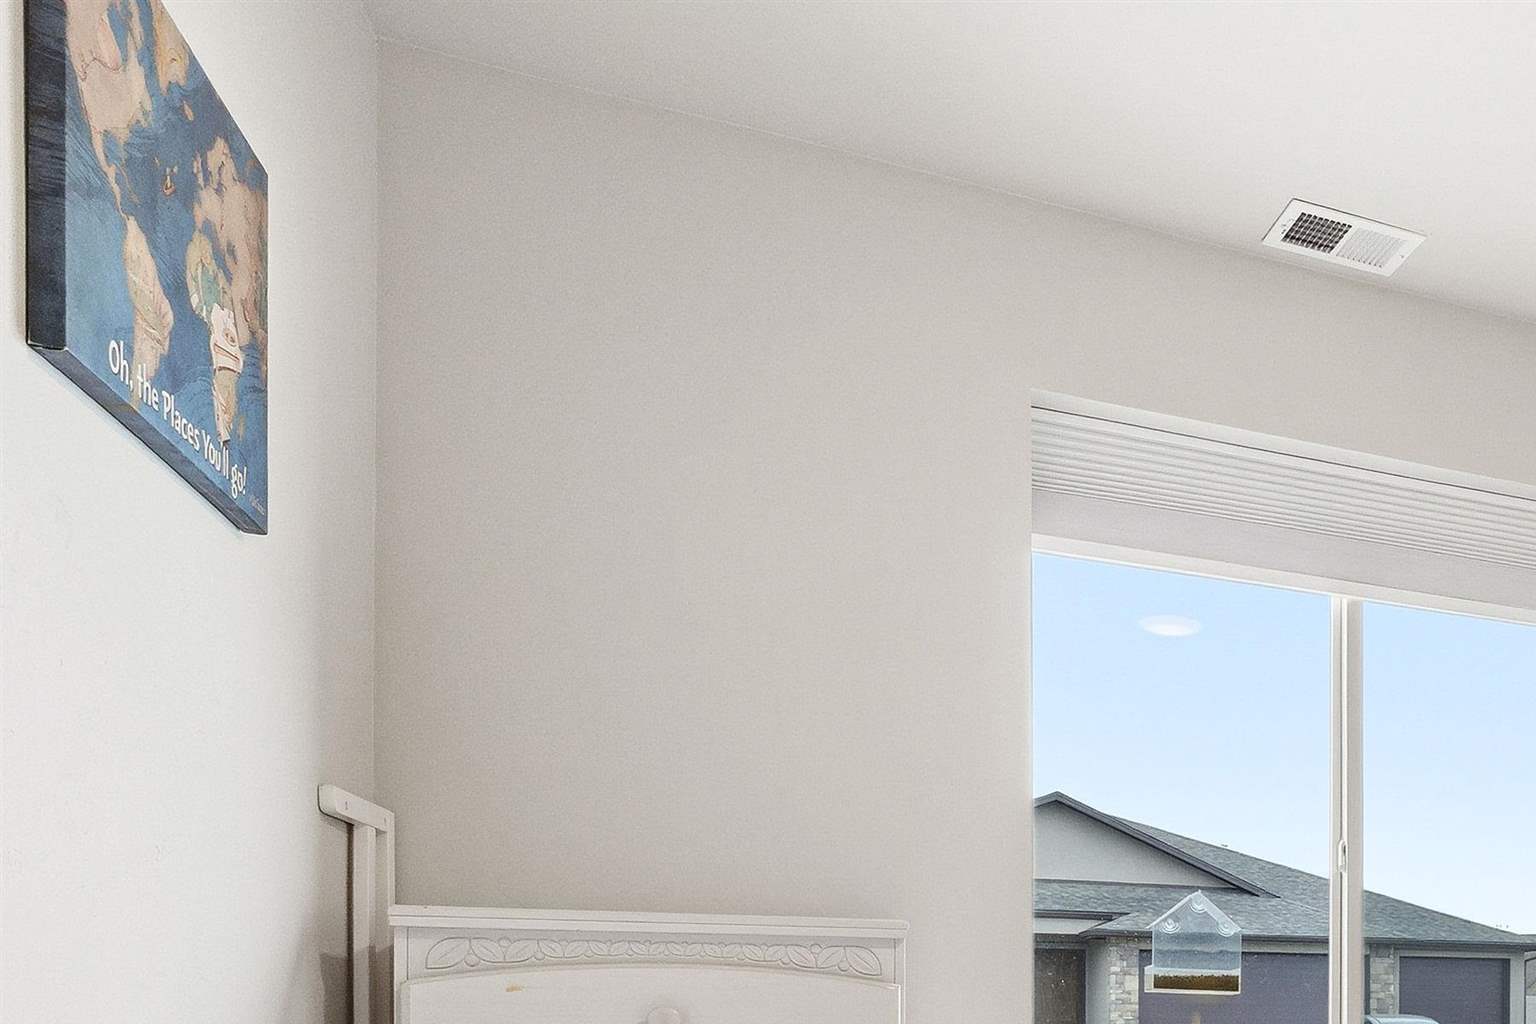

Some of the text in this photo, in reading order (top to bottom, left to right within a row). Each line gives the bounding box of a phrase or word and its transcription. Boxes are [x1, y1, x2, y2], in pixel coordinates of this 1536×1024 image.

[108, 340, 247, 499] Oh, the Places You'll go!
